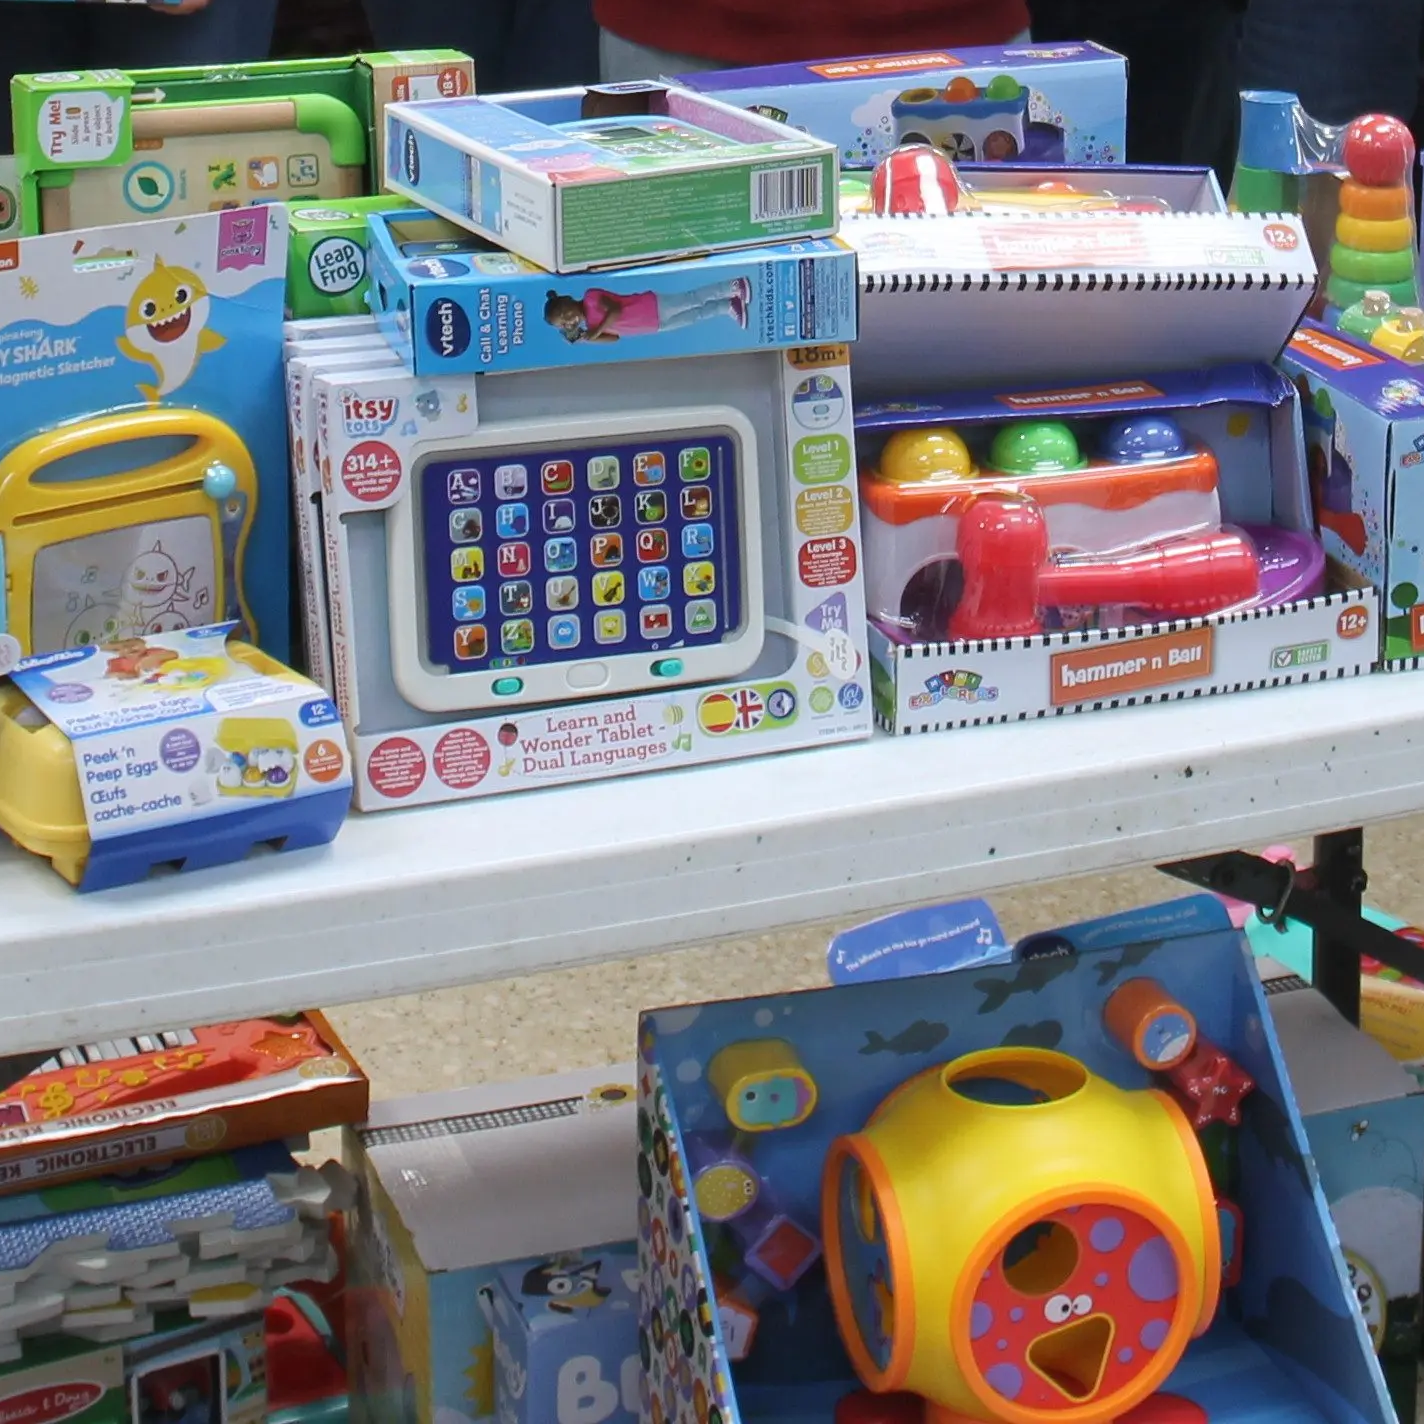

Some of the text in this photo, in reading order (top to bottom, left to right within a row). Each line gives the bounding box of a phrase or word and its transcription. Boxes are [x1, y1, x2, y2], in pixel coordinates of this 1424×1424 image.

[442, 73, 454, 96] 18+
[48, 100, 67, 157] Try Me!
[1266, 227, 1295, 244] 12+
[314, 244, 355, 270] Leap
[319, 259, 362, 288] Frog
[766, 260, 776, 344] vtechkids.com
[440, 300, 454, 357] vtech
[479, 287, 492, 364] Call & Chat
[497, 294, 510, 356] Learning
[512, 301, 524, 346] Phone
[13, 336, 78, 364] SHARK
[57, 355, 117, 376] Sketcher
[342, 395, 394, 422] itsy
[1008, 389, 1093, 406] hammer
[345, 420, 381, 435] tots
[345, 452, 394, 472] 314+
[802, 440, 834, 458] Level
[543, 464, 559, 482] C
[804, 489, 835, 503] Level
[501, 534, 653, 564] N Q
[806, 539, 837, 555] Level
[504, 585, 518, 602] T
[819, 603, 843, 620] Try
[820, 617, 844, 631] Me
[1339, 613, 1367, 630] 12+
[1060, 644, 1203, 687] hammer n Ball
[545, 705, 638, 734] Learn and
[519, 724, 656, 754] Wonder Tablet
[83, 745, 136, 767] Peek 'n
[522, 740, 668, 775] Dual Languages
[85, 759, 159, 785] Peep Eggs
[89, 786, 127, 805] Œufs
[93, 792, 182, 824] cache-cache
[845, 961, 860, 973] The
[891, 941, 904, 952] the
[917, 938, 927, 948] go
[927, 932, 948, 943] round
[948, 927, 960, 938] and
[959, 917, 981, 933] round
[57, 1099, 177, 1129] ELECTRONIC
[35, 1135, 157, 1173] ELECTRONIC
[52, 1387, 93, 1412] Doug
